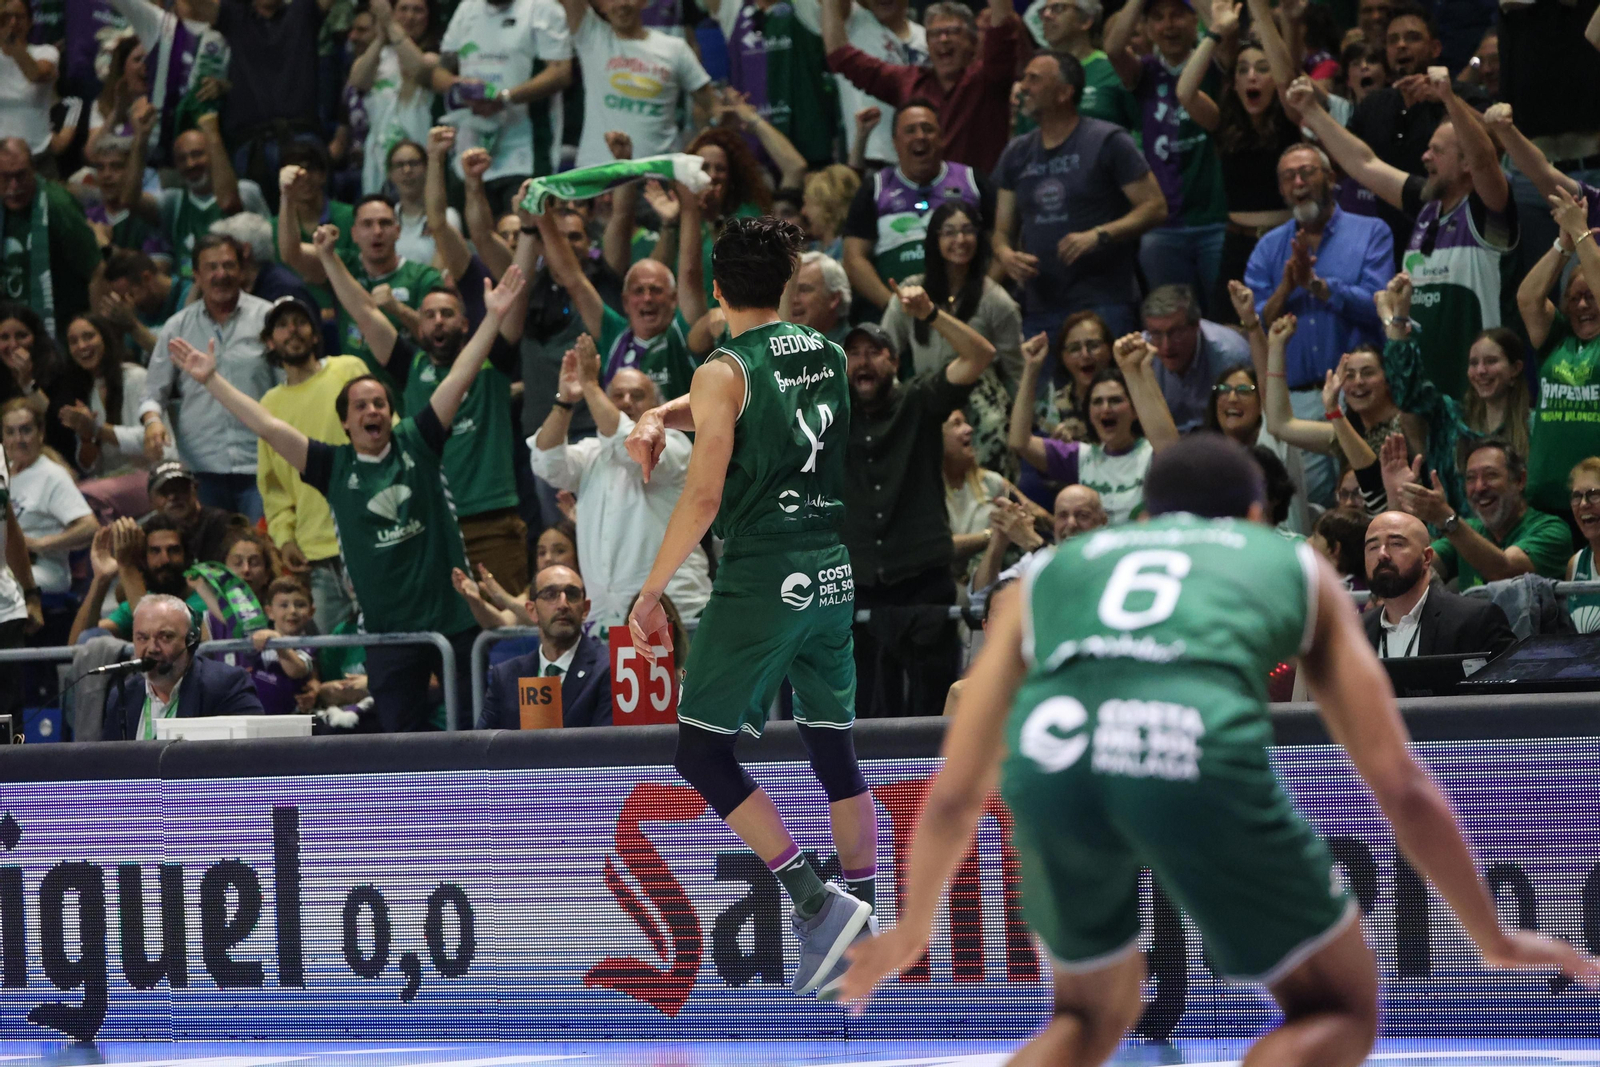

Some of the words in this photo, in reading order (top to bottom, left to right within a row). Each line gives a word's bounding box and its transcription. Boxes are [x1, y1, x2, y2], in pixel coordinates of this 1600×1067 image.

[819, 583, 840, 596] DEL
[1097, 549, 1192, 630] 6
[521, 686, 552, 706] IRS
